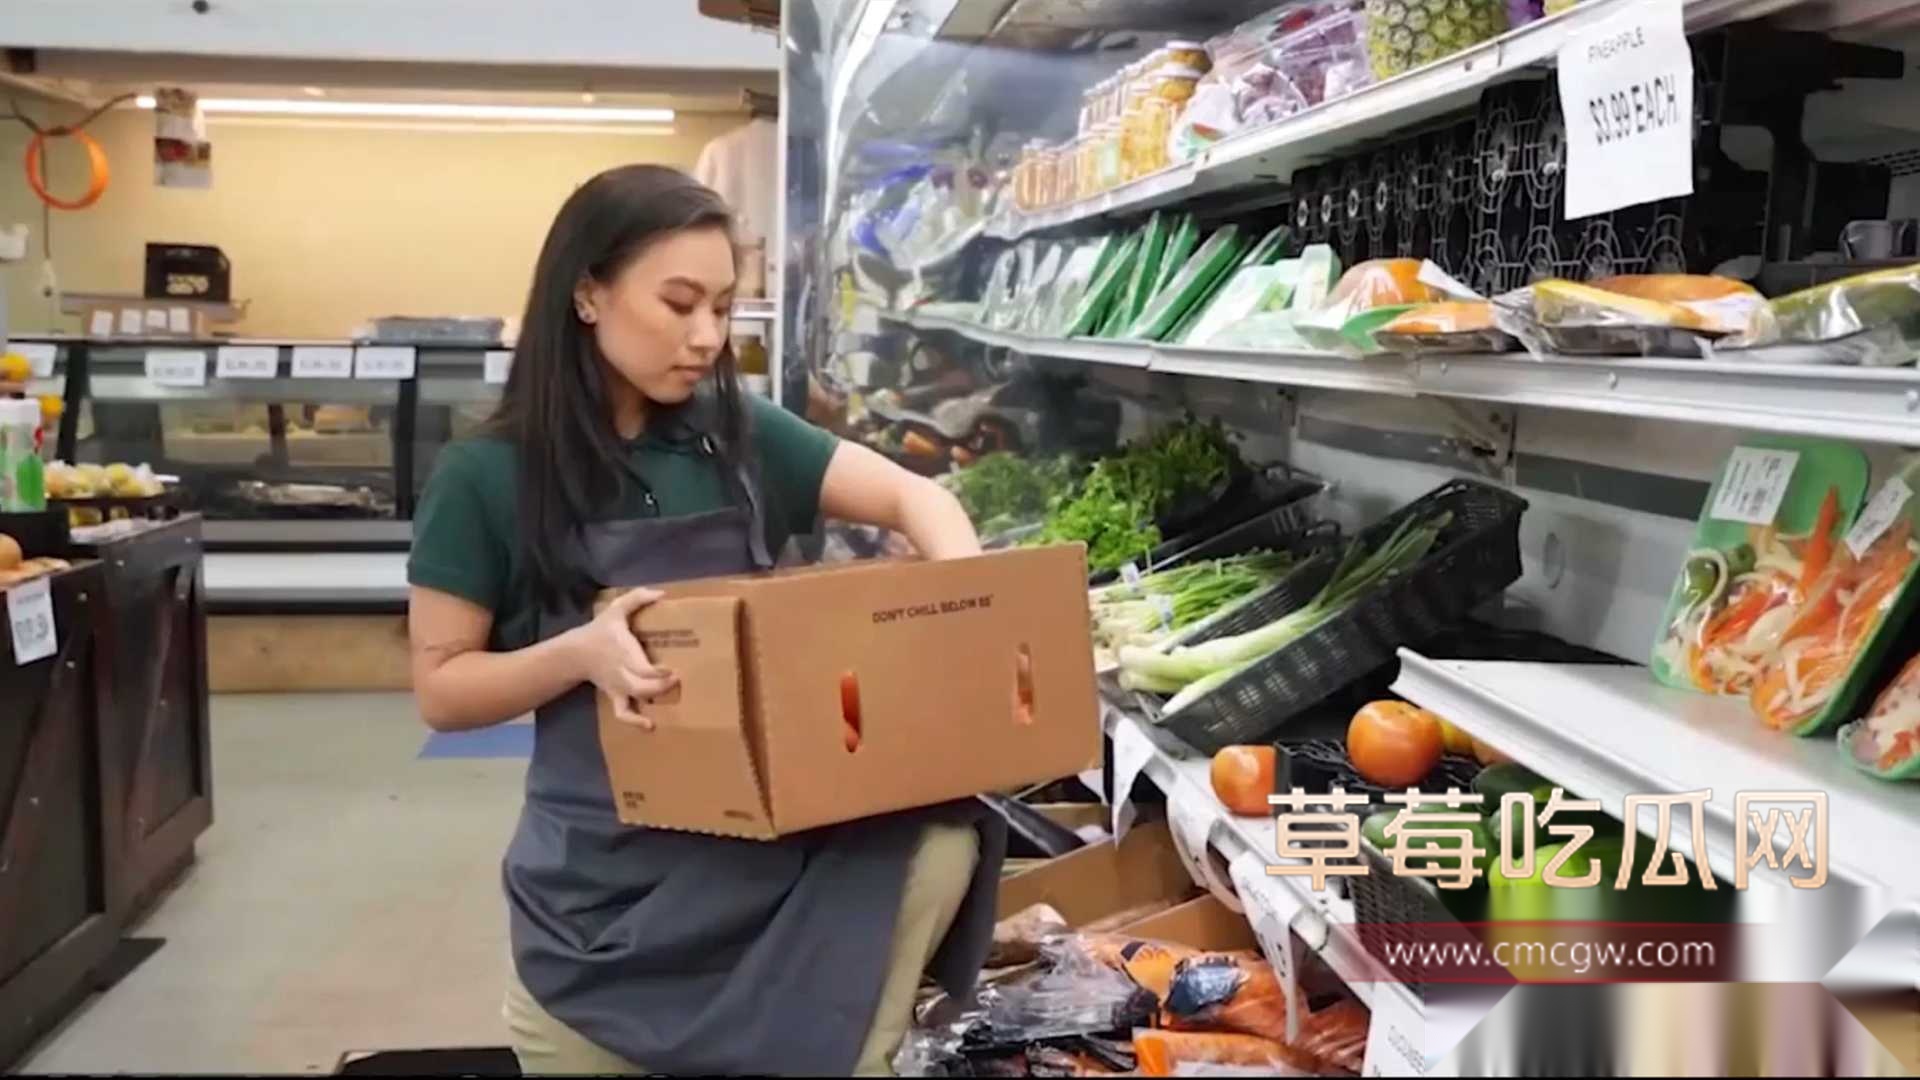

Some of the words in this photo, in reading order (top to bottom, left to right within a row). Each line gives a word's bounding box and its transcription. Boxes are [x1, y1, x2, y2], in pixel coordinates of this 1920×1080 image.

[1588, 26, 1645, 62] PINEAPPLE
[1589, 91, 1630, 146] $3.99
[1631, 74, 1677, 133] EACH
[906, 602, 938, 618] CHILL
